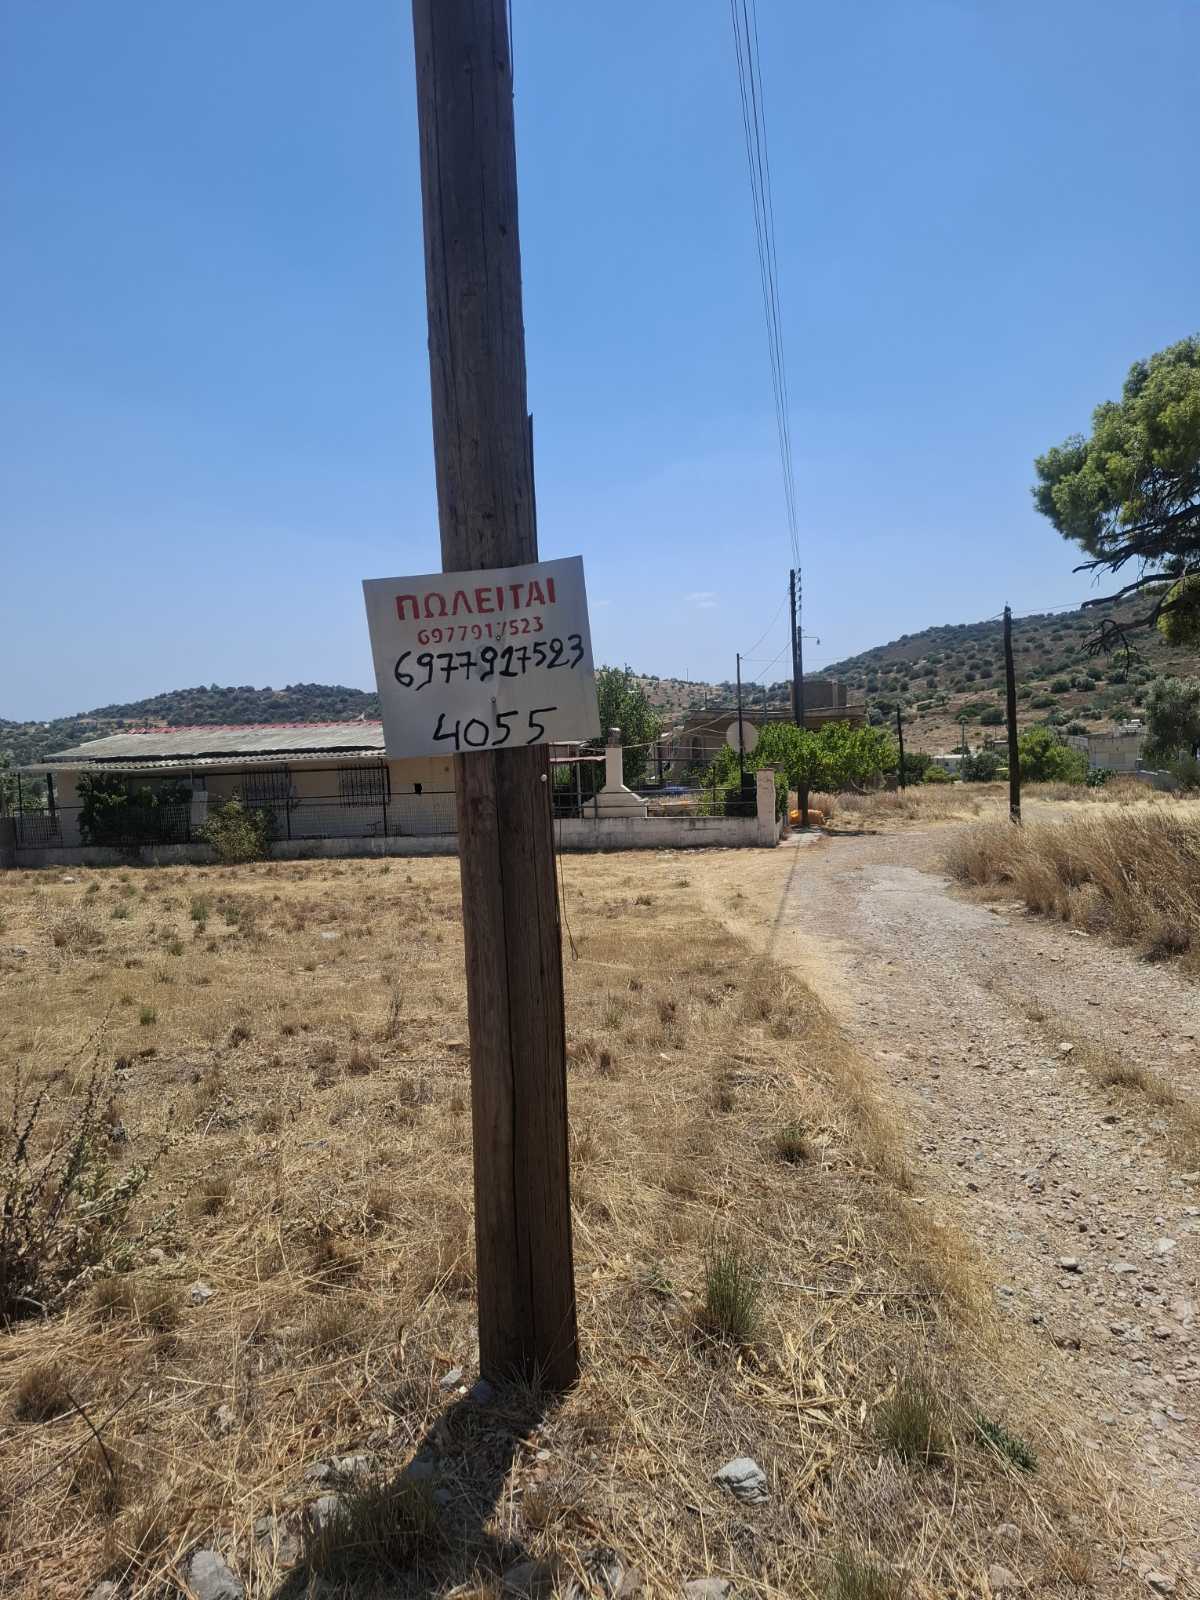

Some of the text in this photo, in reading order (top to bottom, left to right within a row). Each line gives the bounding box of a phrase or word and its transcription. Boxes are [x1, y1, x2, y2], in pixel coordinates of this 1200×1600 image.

[396, 578, 556, 620] ΠΩΛΕΙΤΑΙ
[394, 634, 584, 691] 6977917523
[432, 706, 557, 750] 4055
